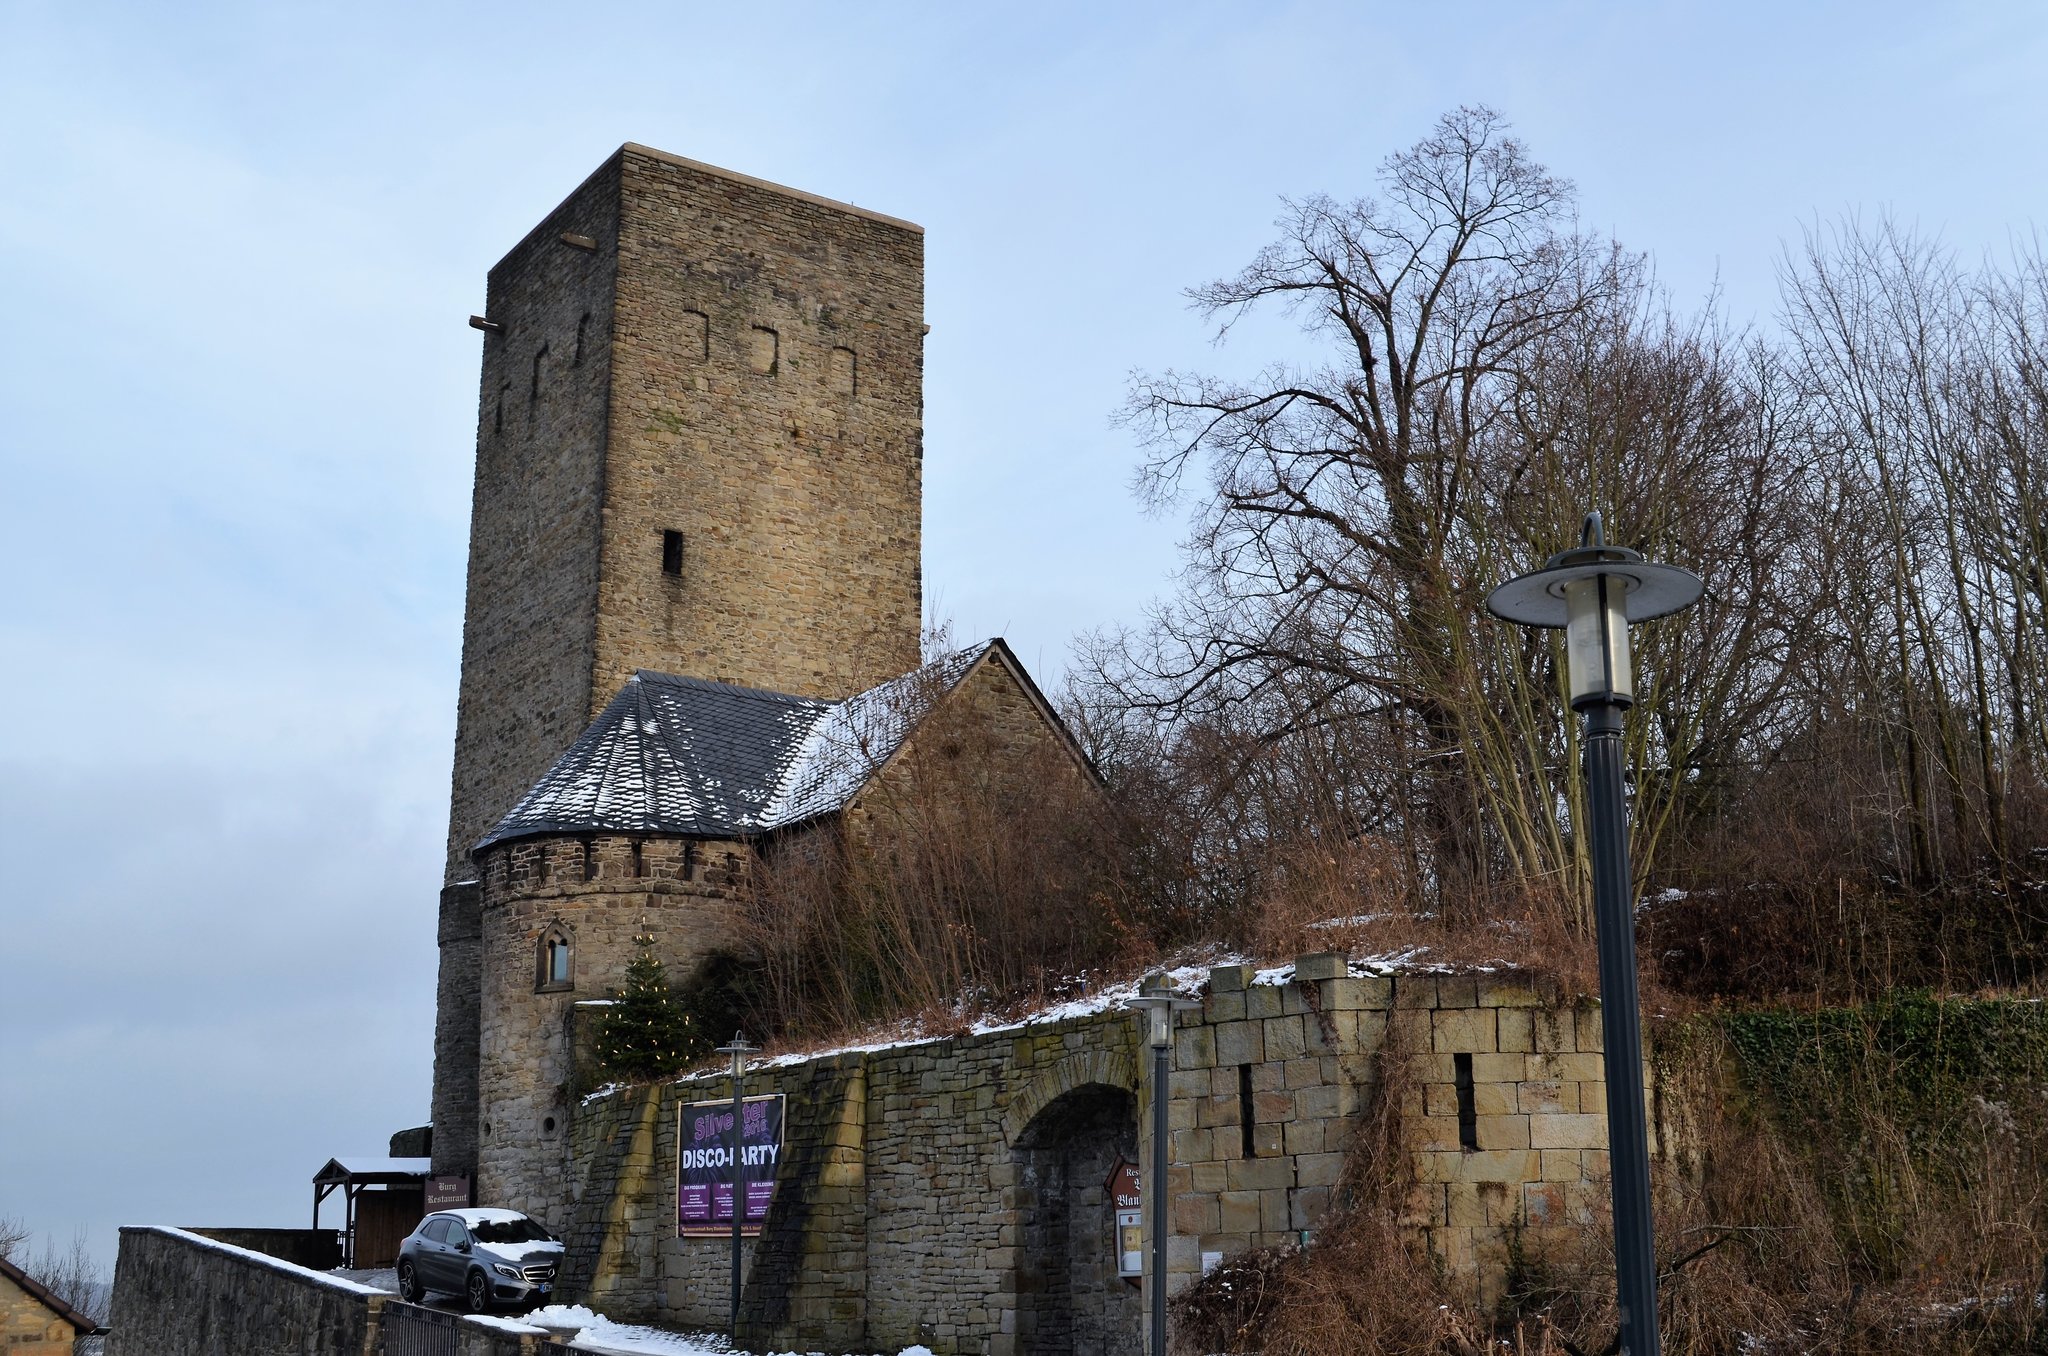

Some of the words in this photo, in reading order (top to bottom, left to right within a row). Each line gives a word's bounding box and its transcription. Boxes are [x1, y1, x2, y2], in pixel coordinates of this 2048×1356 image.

[694, 1101, 769, 1140] Silveter
[438, 1182, 457, 1191] Burg
[427, 1194, 467, 1204] Restaurant
[1117, 1194, 1142, 1207] Blan
